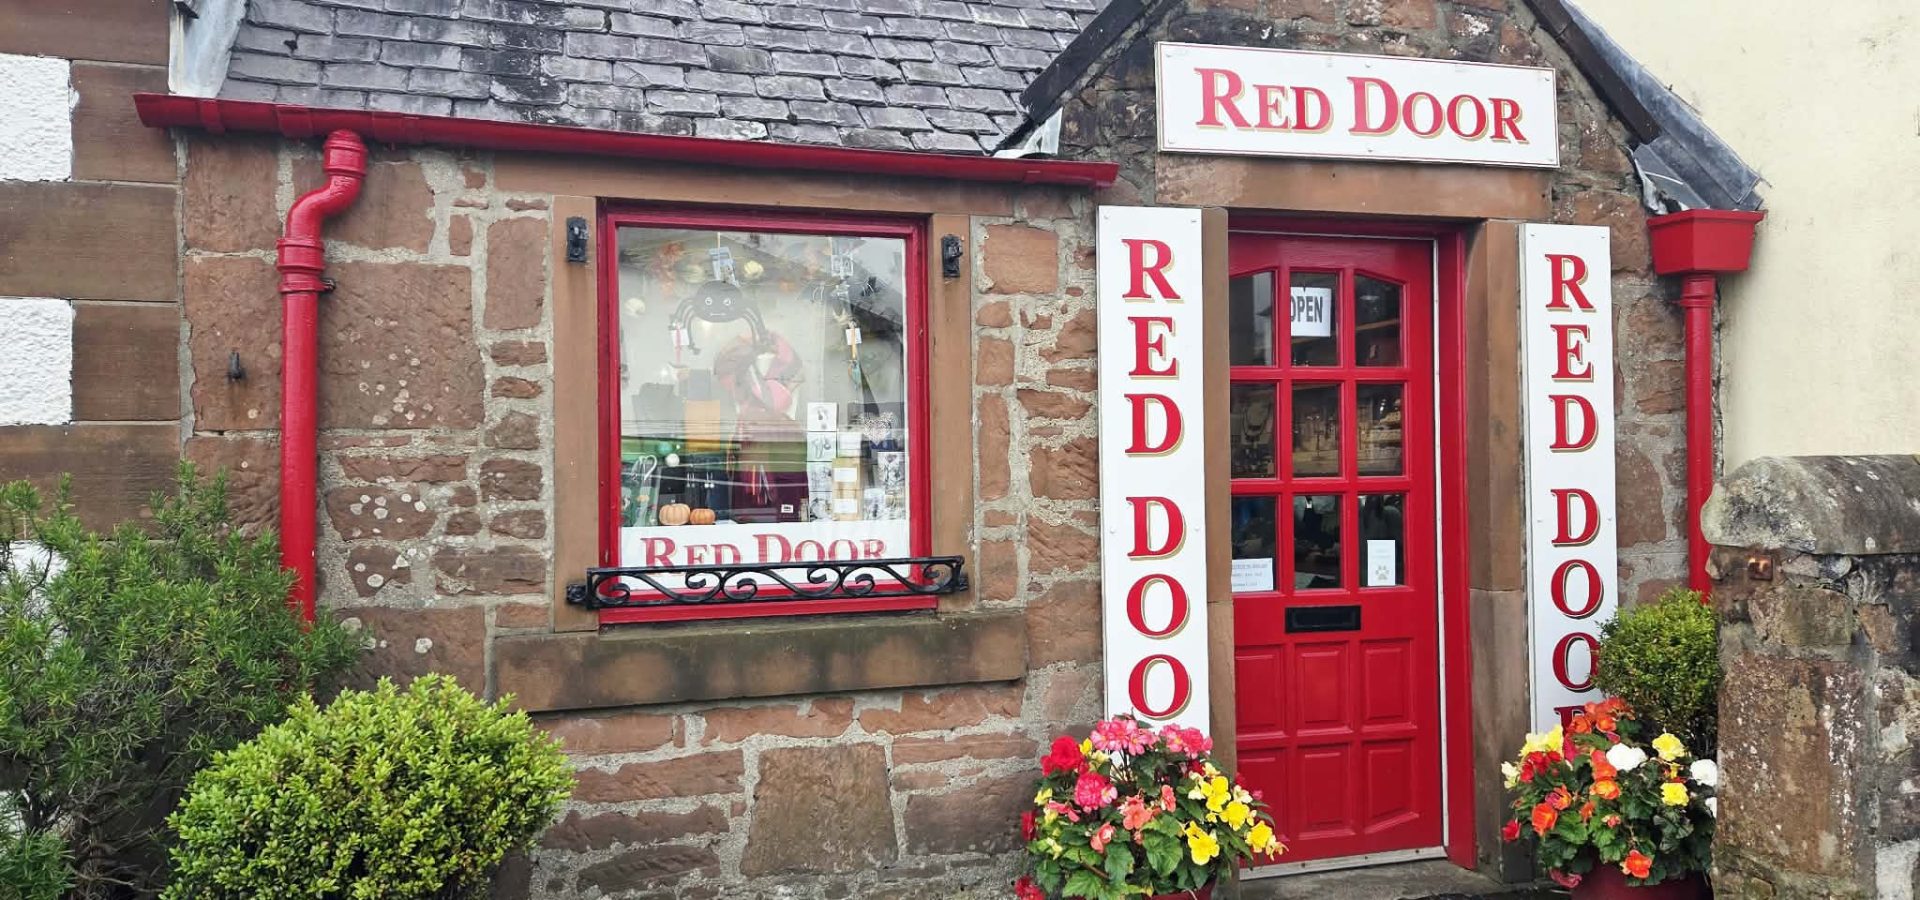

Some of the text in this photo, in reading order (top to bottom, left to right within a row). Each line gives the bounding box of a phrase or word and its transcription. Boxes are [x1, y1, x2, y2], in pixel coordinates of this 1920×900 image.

[1194, 67, 1530, 145] RED DOOR
[1544, 253, 1597, 453] RED
[1121, 238, 1192, 721] RED DOO
